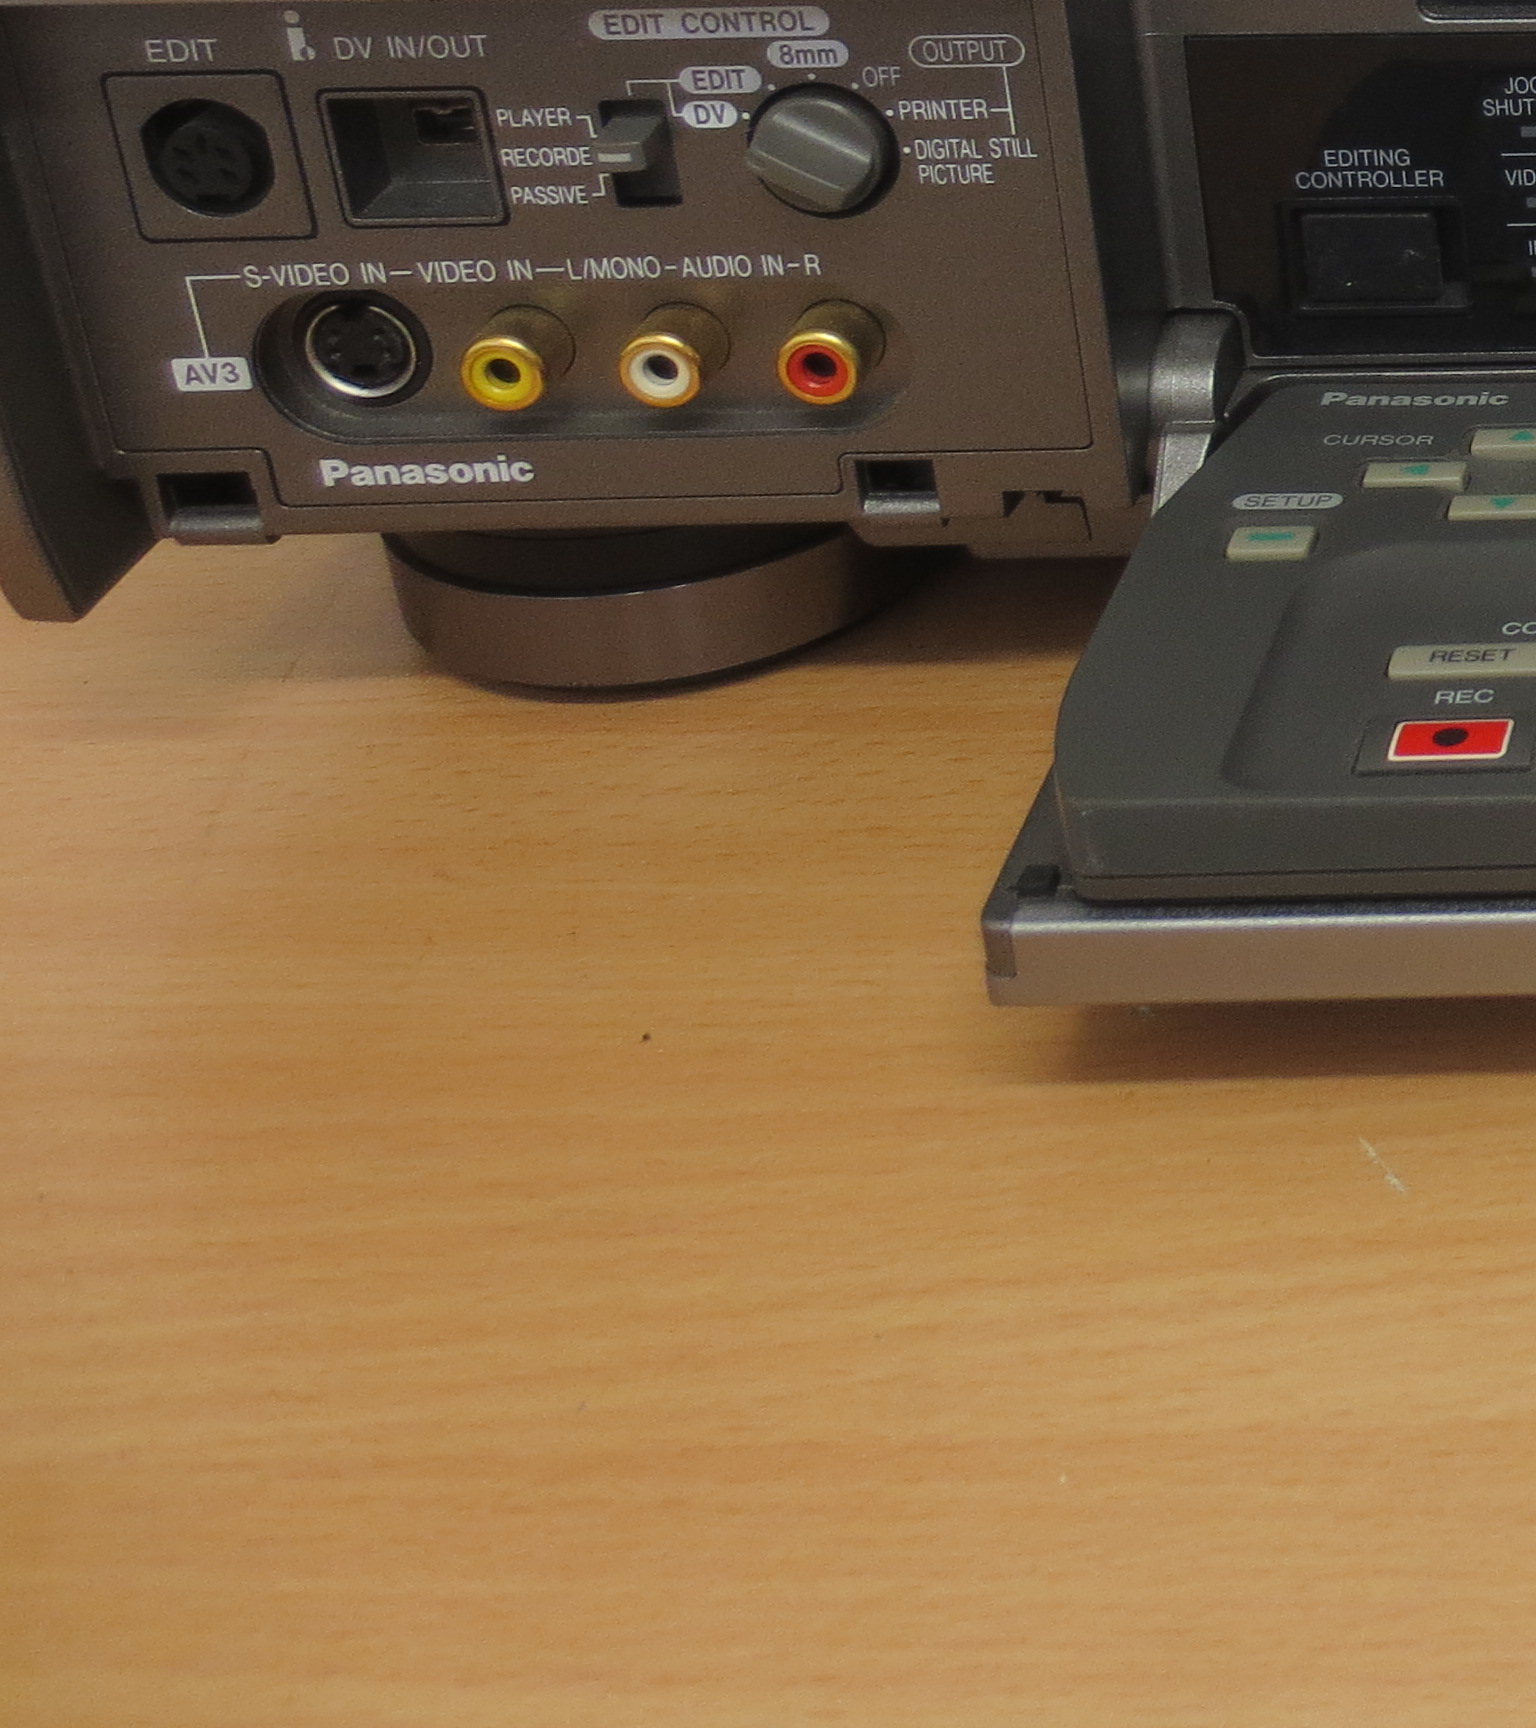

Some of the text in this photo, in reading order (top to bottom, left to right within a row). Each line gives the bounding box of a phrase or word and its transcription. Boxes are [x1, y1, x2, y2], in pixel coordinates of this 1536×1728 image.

[604, 11, 815, 36] EDIT CONTROL
[145, 39, 217, 62] EDIT
[334, 34, 487, 59] DV IN/OUT
[779, 45, 837, 65] 8mm
[922, 39, 1007, 63] OUTPUT
[693, 69, 745, 91] EDIT
[863, 67, 901, 88] OFF
[496, 107, 572, 127] PLAYER
[694, 104, 726, 125] DV
[899, 100, 988, 120] PRINTER
[500, 147, 593, 167] RECORDE
[915, 138, 1037, 160] DIGITAL STILL
[1323, 149, 1411, 167] EDITING
[918, 164, 995, 185] PICTURE
[1295, 170, 1444, 189] CONTROLLER
[511, 185, 589, 205] PASSIVE
[417, 259, 496, 284] VIDEO
[682, 255, 752, 278] AUDIO
[184, 361, 240, 385] AV3
[1320, 391, 1509, 407] Panasonic
[1323, 434, 1434, 447] CURSOR
[320, 456, 534, 487] Panasonic
[1244, 493, 1333, 508] SETUP
[1428, 648, 1516, 663] RESET
[1434, 688, 1495, 705] REC
